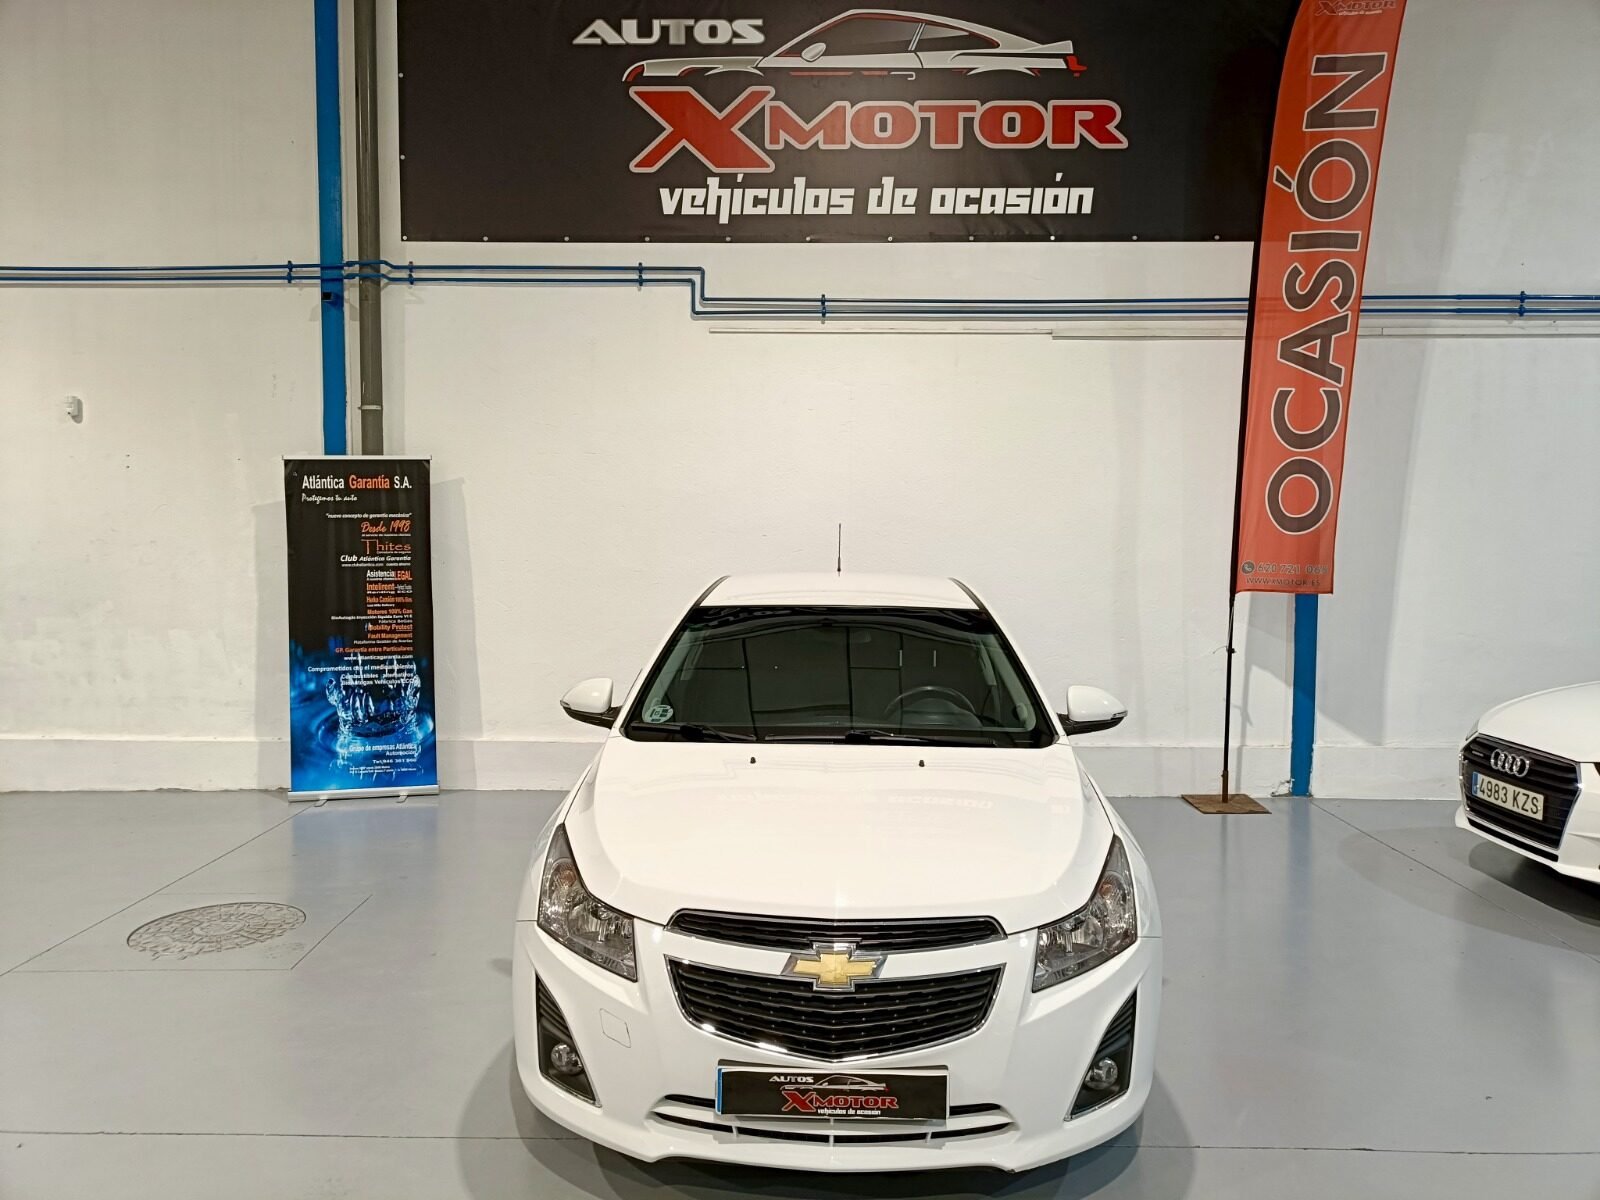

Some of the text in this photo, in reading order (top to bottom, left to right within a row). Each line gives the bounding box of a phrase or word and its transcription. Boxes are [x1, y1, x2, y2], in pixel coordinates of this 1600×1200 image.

[572, 18, 766, 46] AUTOS
[628, 85, 1129, 173] XMOTOR
[659, 171, 1095, 225] vehículos de ocasión
[1264, 52, 1388, 535] OCASIÓN
[302, 475, 413, 489] Atlántica Garantía S.A.
[335, 494, 343, 502] tu
[343, 494, 358, 502] auto
[360, 518, 412, 534] Desde 1998
[360, 538, 412, 555] Thites
[340, 554, 358, 563] Club
[366, 570, 395, 578] Asistencia
[1479, 778, 1539, 815] 4983 KZS
[769, 1075, 814, 1083] AUTOS
[782, 1091, 898, 1112] XMOTOR
